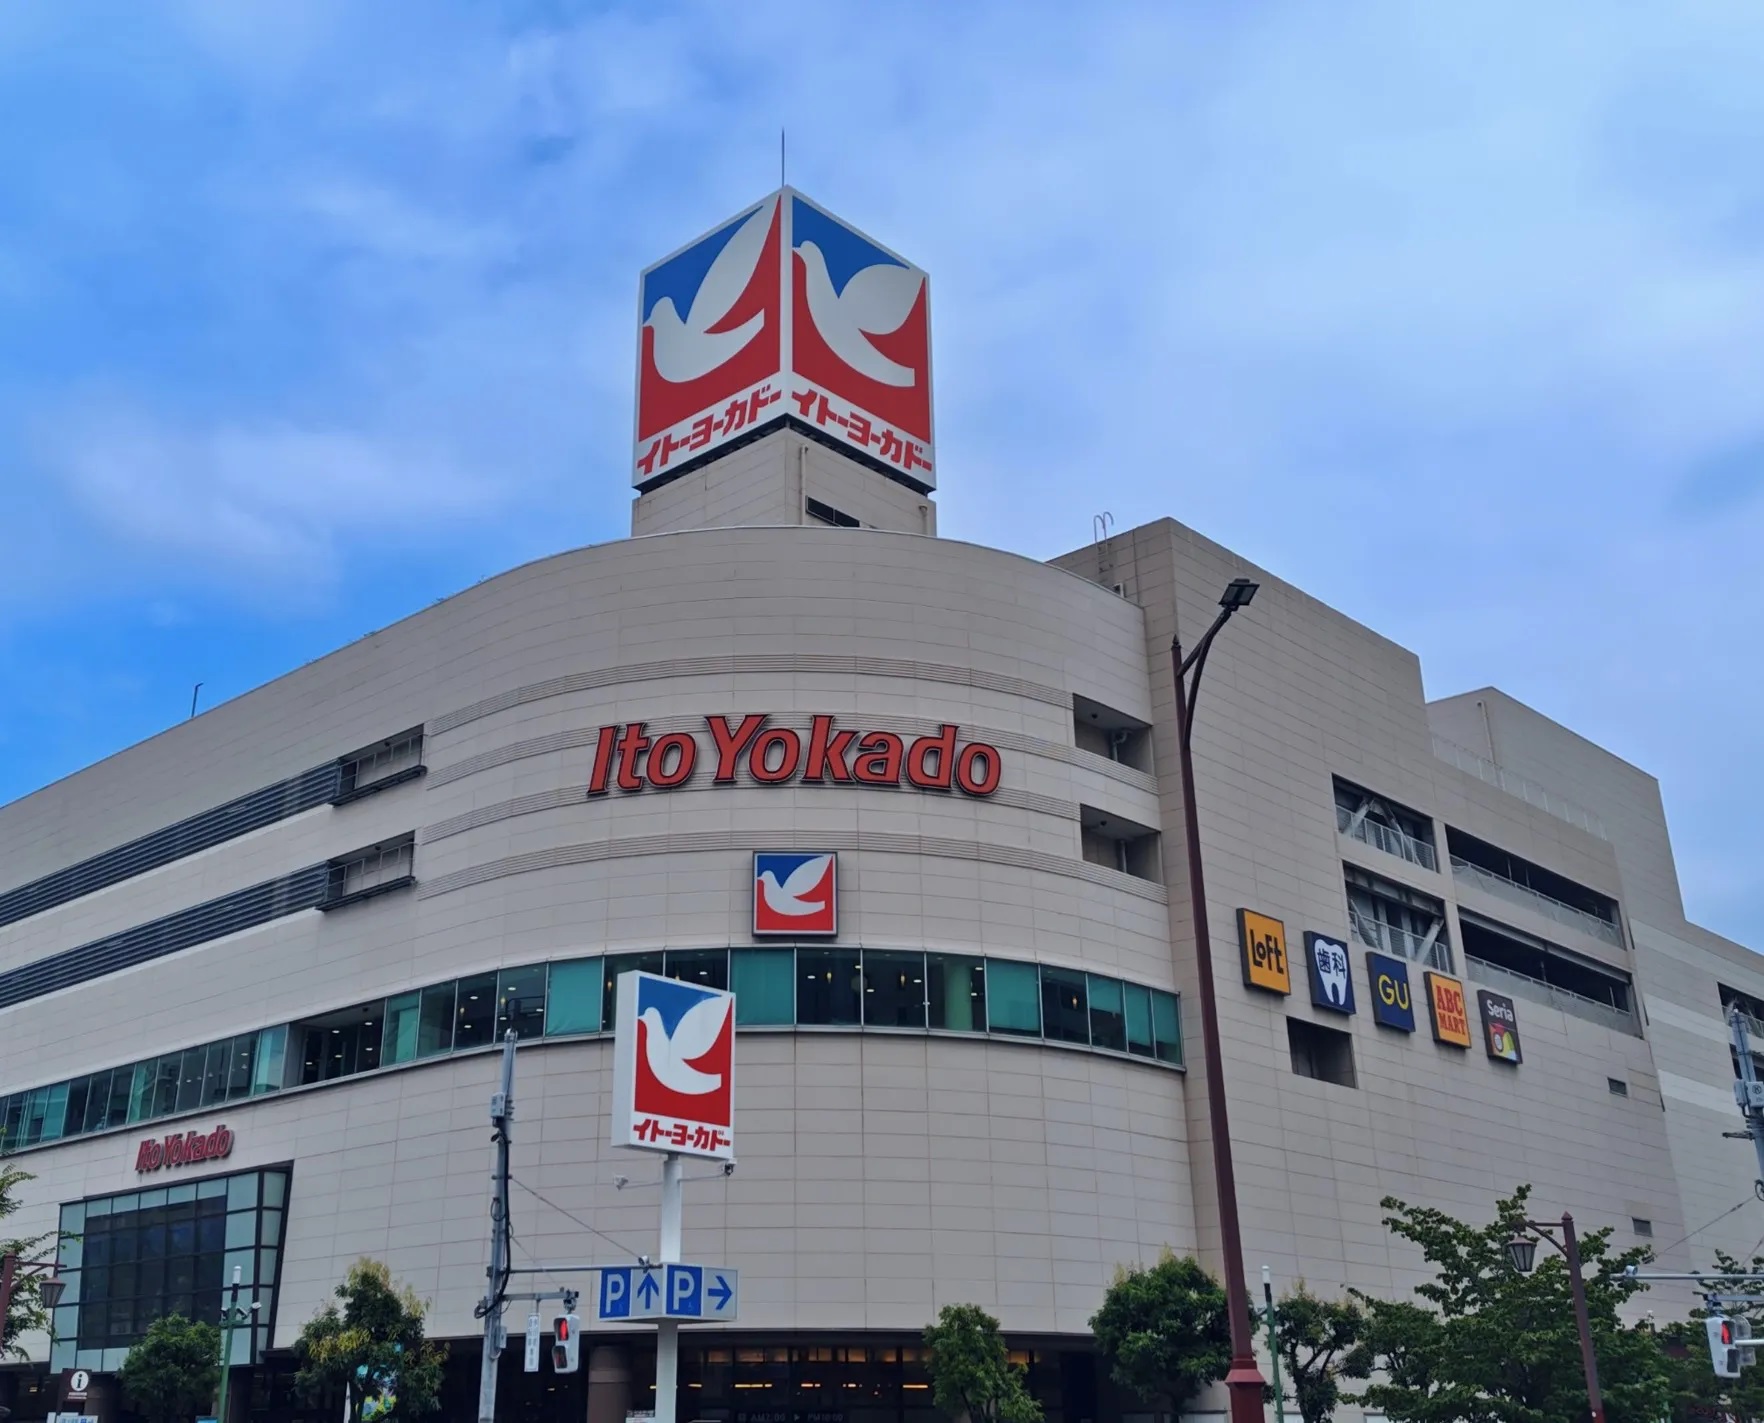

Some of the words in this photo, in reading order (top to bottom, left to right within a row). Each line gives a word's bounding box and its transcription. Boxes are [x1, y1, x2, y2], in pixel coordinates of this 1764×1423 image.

[637, 383, 782, 476] イトーヨーカドー
[792, 388, 932, 472] イトーヨーカドー
[1316, 948, 1346, 979] 歯科
[1378, 974, 1409, 1010] GU
[1435, 984, 1463, 1016] ABC
[1438, 1011, 1466, 1036] MART
[1486, 999, 1514, 1023] Seria
[633, 1118, 731, 1151] イトーヨーカドー
[605, 1273, 625, 1314] P
[673, 1270, 695, 1311] P
